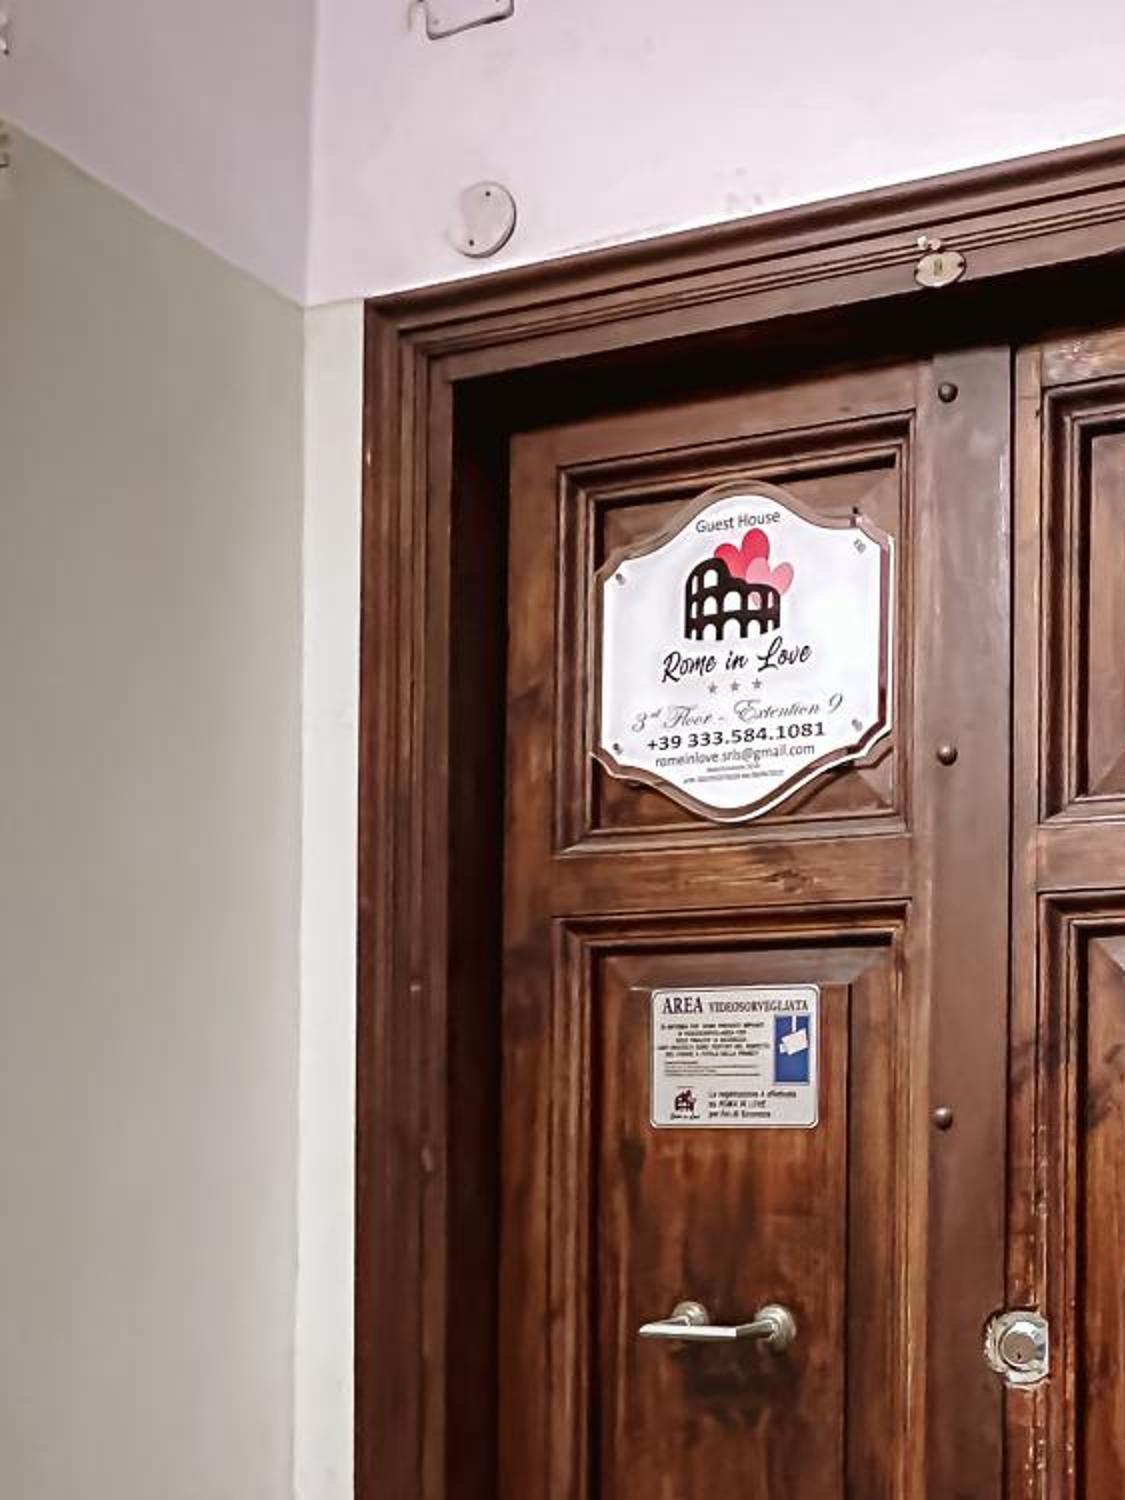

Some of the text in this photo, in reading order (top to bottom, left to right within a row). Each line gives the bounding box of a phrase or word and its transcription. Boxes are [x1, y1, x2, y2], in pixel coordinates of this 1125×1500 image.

[695, 511, 781, 533] Guest House
[661, 635, 812, 683] Rome in Love
[663, 704, 712, 729] Floor
[734, 698, 820, 723] Extention
[647, 722, 825, 751] +39 333.584.1081
[655, 744, 815, 768] romeinlove.srls@gmail.com
[662, 997, 703, 1014] AREA
